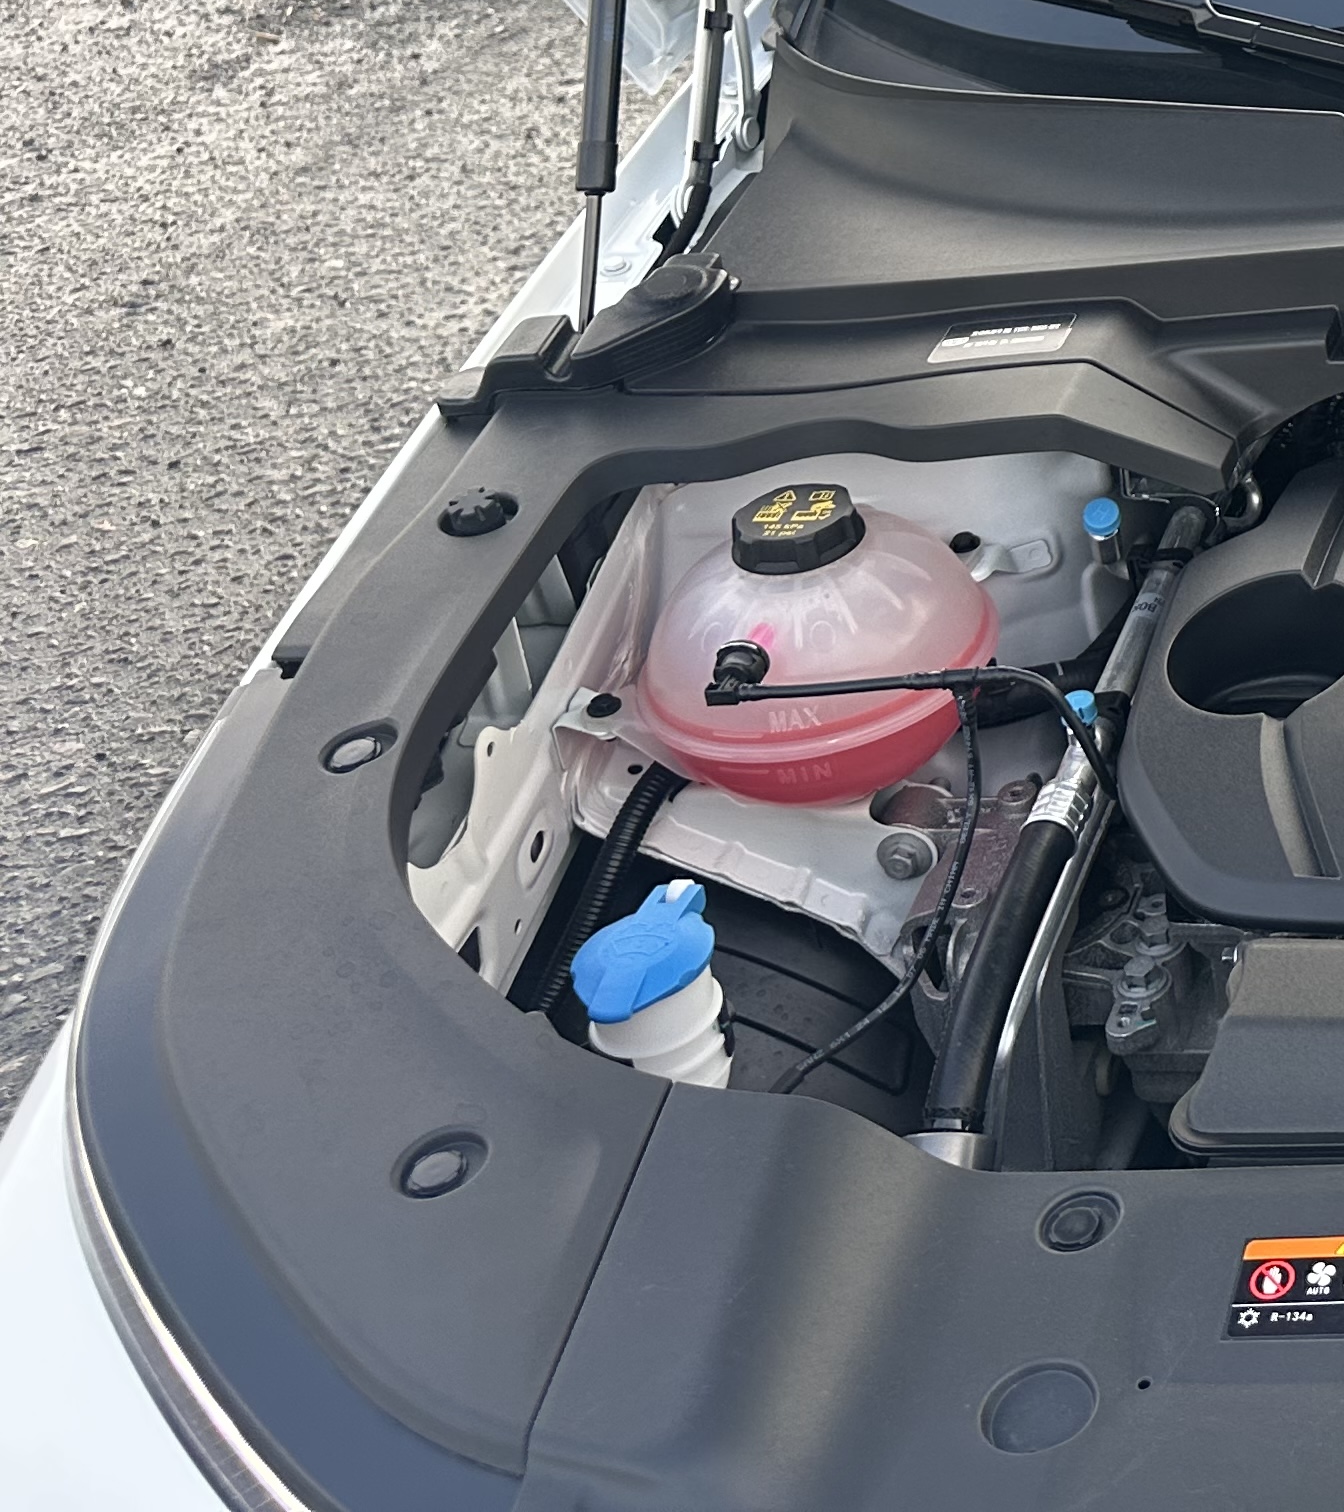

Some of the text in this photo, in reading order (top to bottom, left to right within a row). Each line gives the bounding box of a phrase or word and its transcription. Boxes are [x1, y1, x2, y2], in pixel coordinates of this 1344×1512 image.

[768, 704, 824, 733] MAX
[777, 761, 834, 786] MIN
[1306, 1286, 1330, 1296] AUTO
[1270, 1311, 1314, 1322] R-134a
